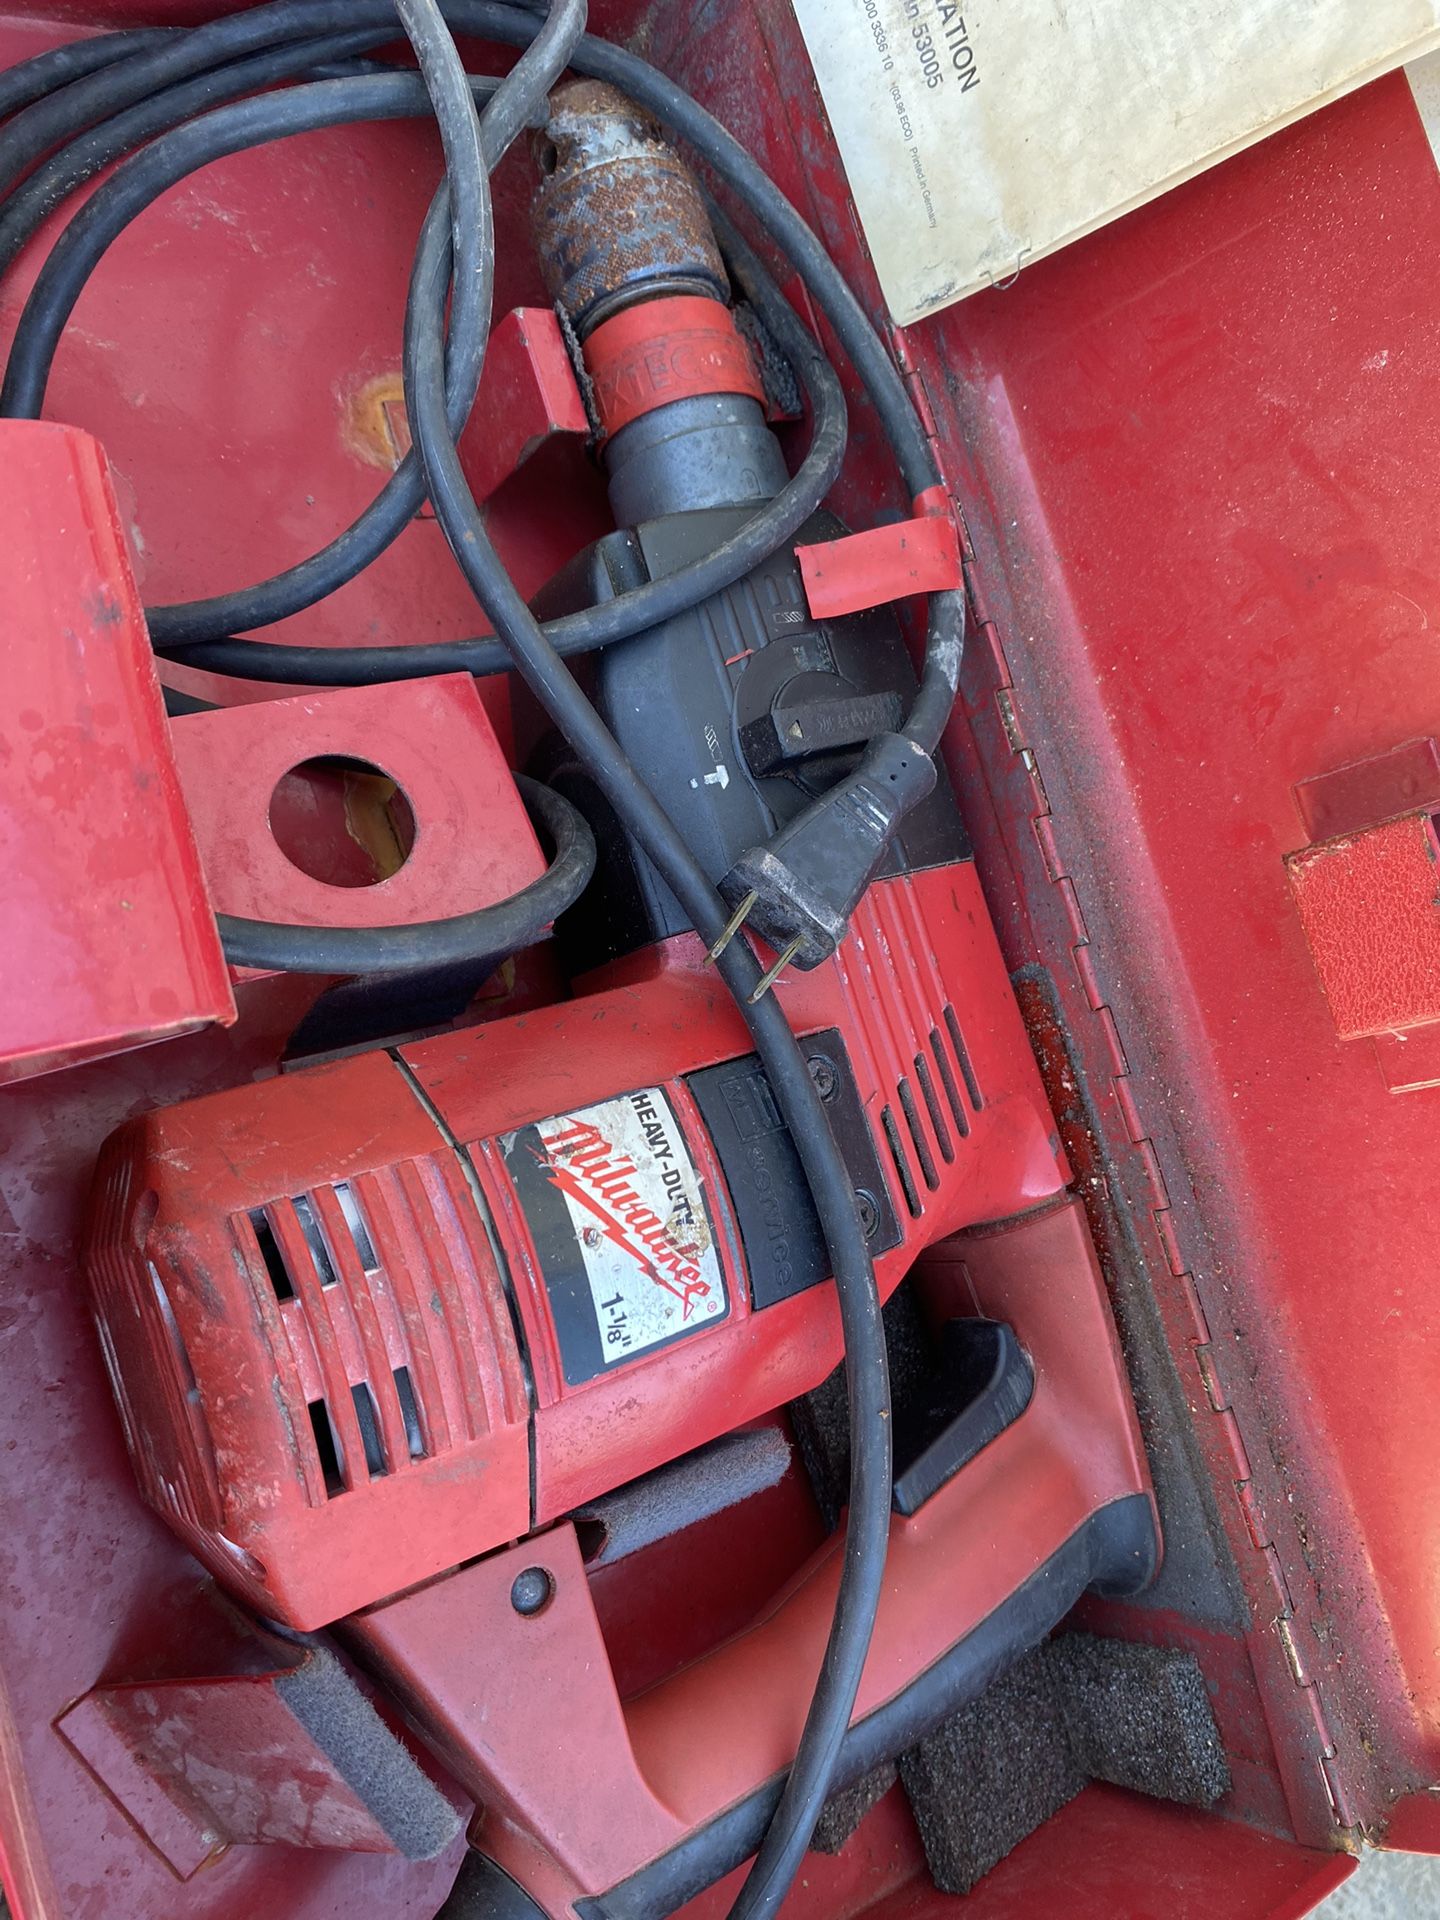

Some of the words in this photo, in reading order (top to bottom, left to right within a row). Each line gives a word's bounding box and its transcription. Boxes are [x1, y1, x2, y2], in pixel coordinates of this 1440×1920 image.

[871, 20, 888, 52] 3336
[882, 54, 894, 71] 10
[910, 146, 925, 179] Printed
[922, 190, 938, 228] Germany
[912, 23, 944, 88] 53005
[541, 1117, 712, 1297] Milwaukee
[631, 1094, 694, 1226] HEAVY-DUTY
[748, 1147, 793, 1287] service
